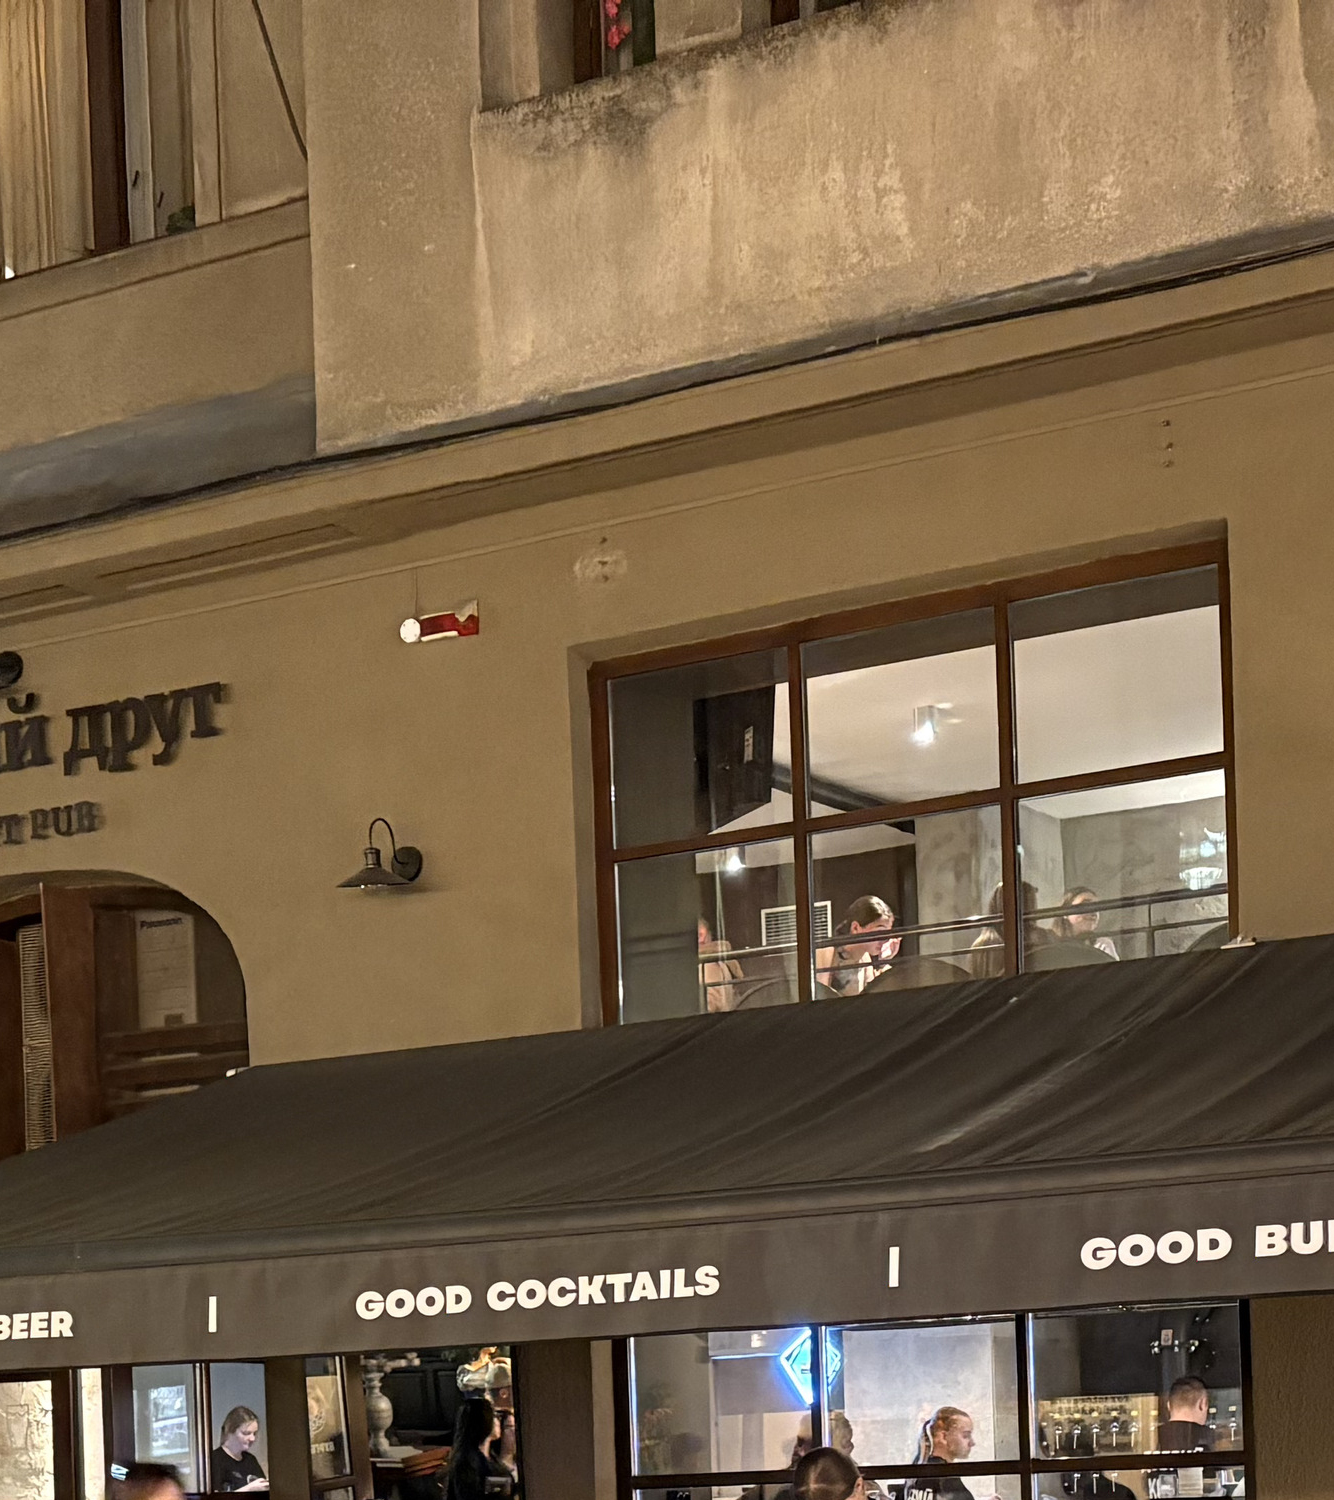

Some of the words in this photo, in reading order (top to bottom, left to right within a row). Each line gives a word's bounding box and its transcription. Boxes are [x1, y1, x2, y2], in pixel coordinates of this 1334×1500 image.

[64, 681, 223, 776] друг
[29, 801, 99, 840] PUB
[1080, 1227, 1233, 1270] GOOD
[355, 1284, 472, 1320] GOOD
[486, 1265, 720, 1312] COCKTAILS
